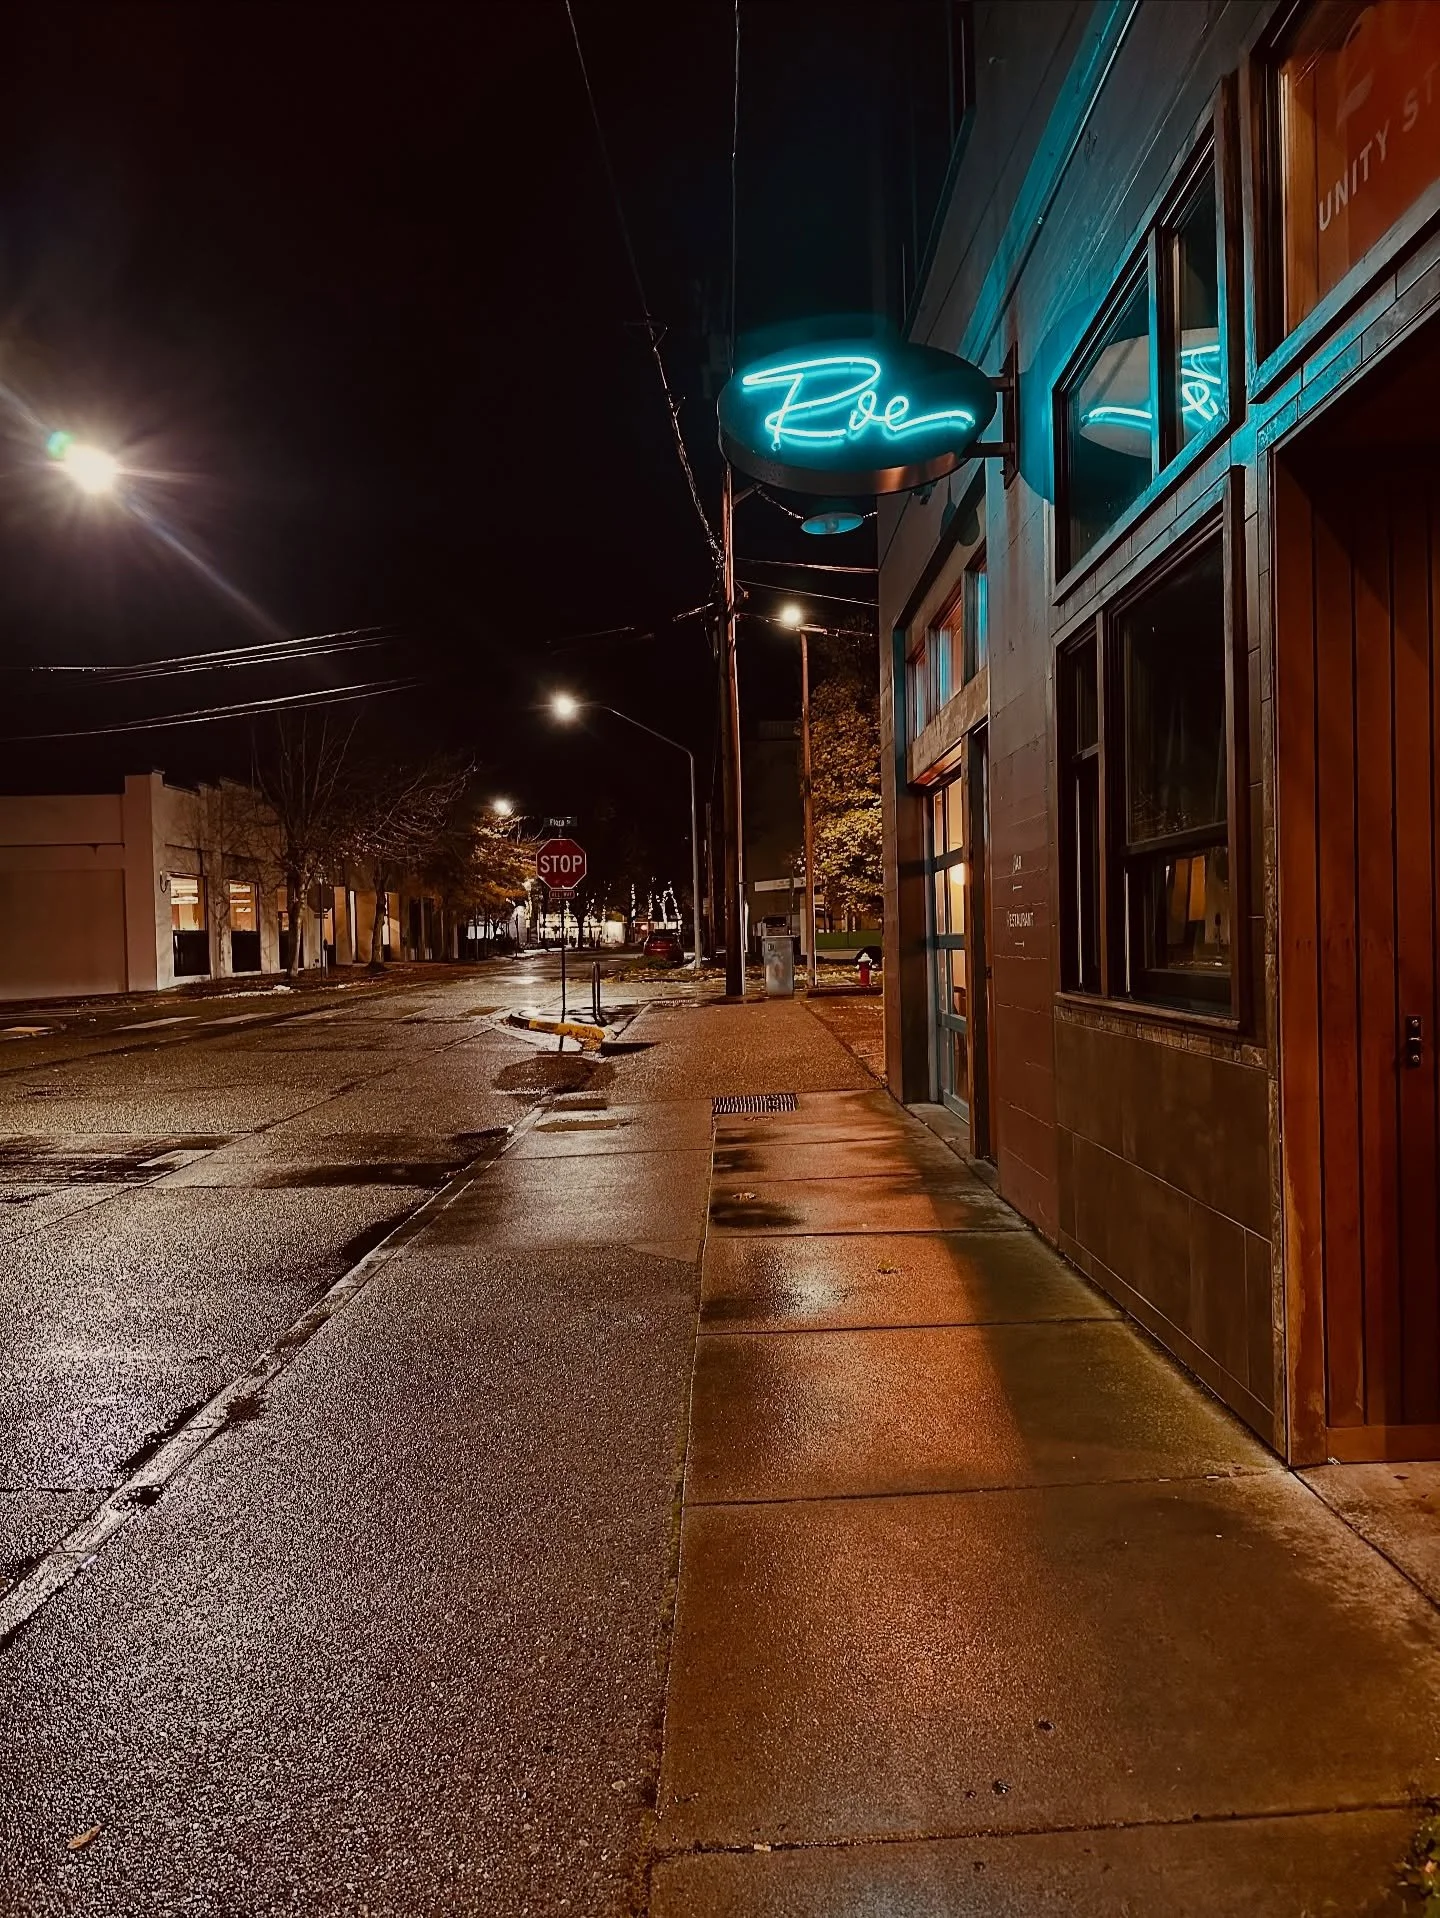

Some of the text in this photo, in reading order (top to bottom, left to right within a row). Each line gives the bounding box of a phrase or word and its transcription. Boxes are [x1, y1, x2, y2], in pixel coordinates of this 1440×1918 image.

[1318, 118, 1391, 232] UNITY
[742, 356, 976, 451] Roe
[540, 855, 583, 873] STOP
